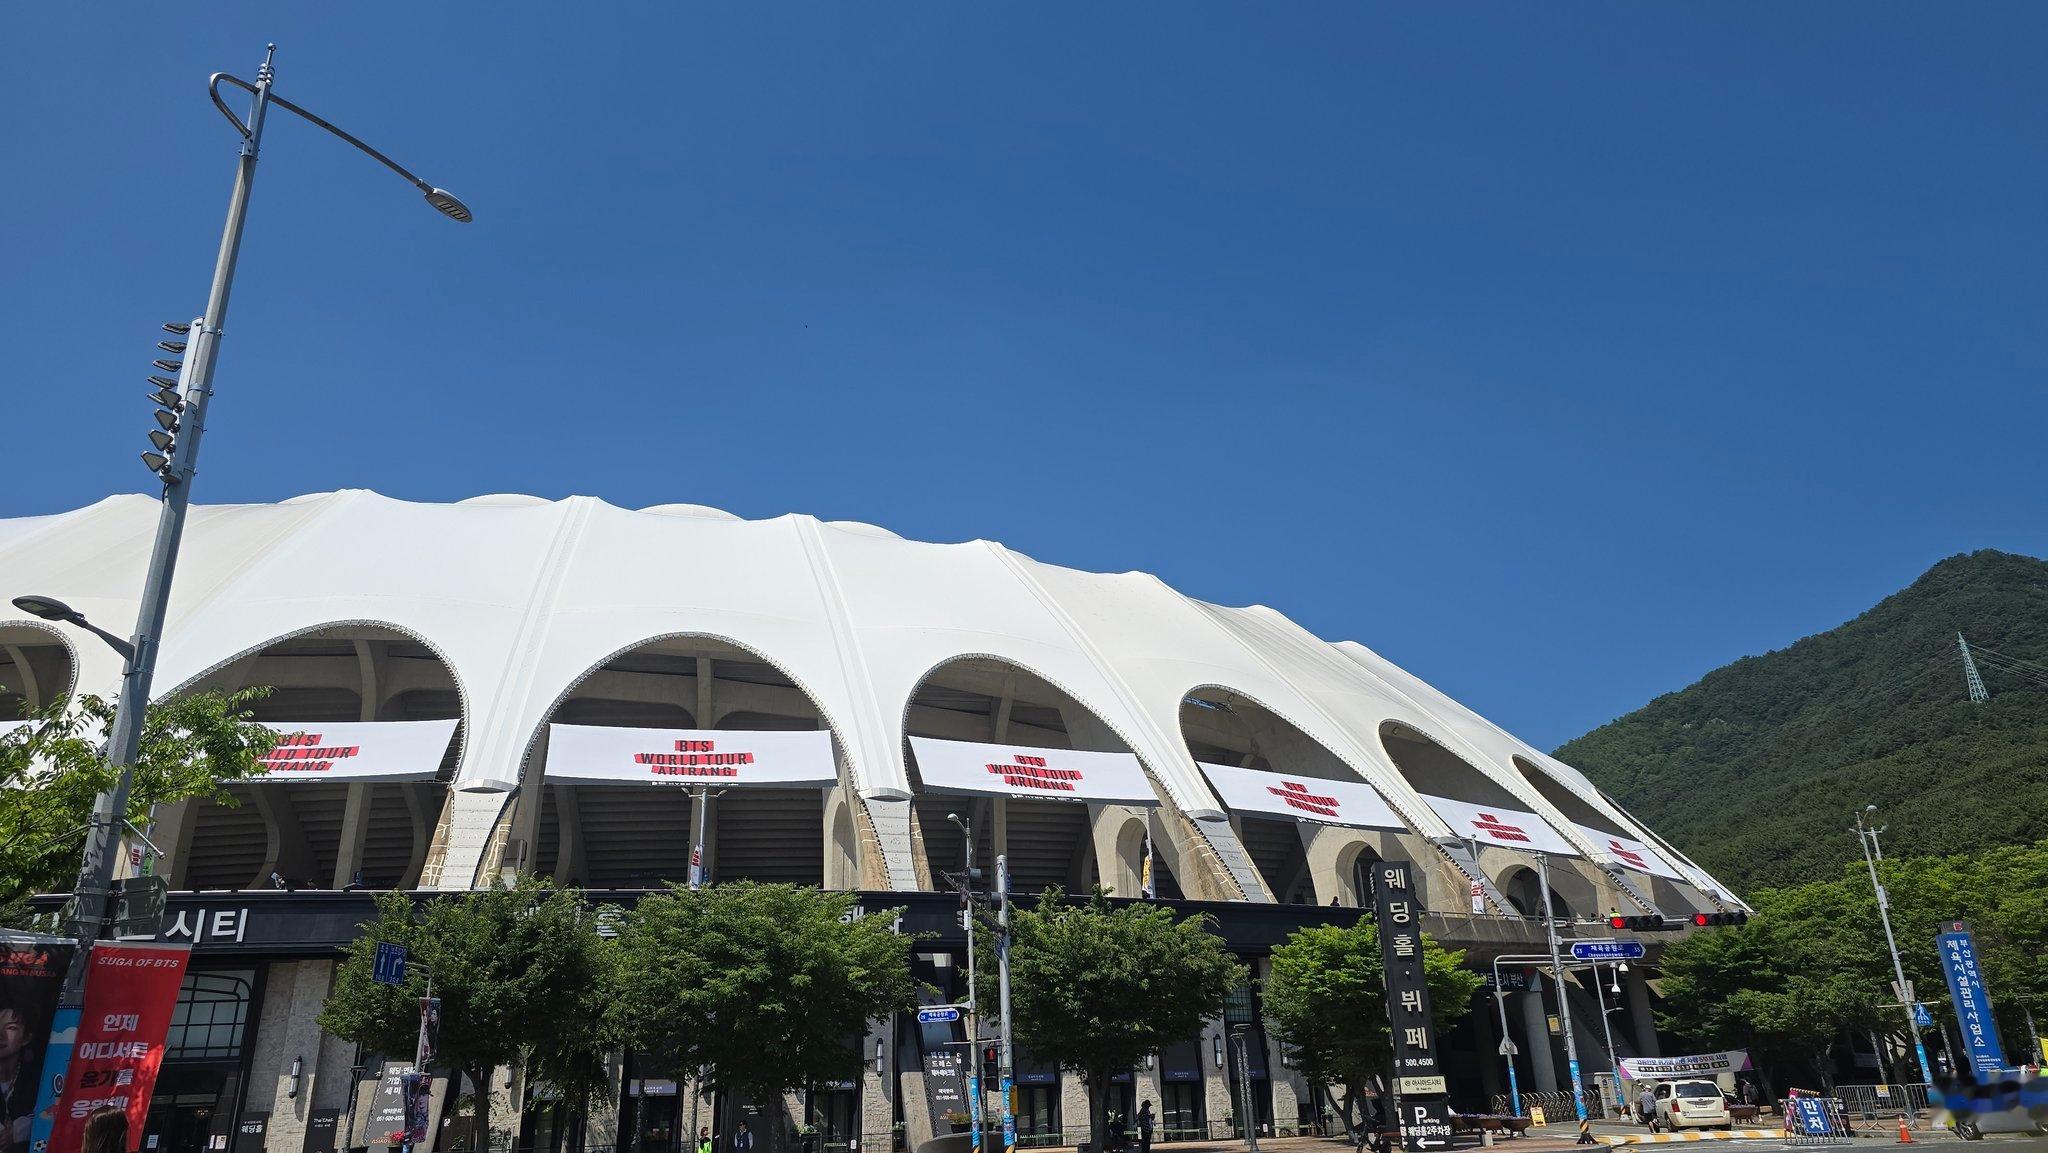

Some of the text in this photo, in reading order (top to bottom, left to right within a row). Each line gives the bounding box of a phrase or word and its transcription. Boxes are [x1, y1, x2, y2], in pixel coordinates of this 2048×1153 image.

[280, 734, 317, 746] BTS
[680, 740, 709, 752] BTS
[305, 747, 352, 759] TOUR
[640, 753, 747, 765] WORLD TOUR
[266, 761, 327, 771] IRANG
[1018, 756, 1043, 766] BTS
[658, 766, 732, 776] ARIRANG
[992, 764, 1078, 781] WORLD TOUR
[1010, 776, 1070, 791] ARIRANG
[1590, 944, 1624, 952] 체육공원로
[98, 956, 180, 968] SUGA OF BTS
[1960, 939, 1980, 989] 부산광역시
[1946, 939, 1986, 1047] 체육시설관리사업소
[102, 1014, 139, 1032] 언제
[80, 1041, 149, 1059] 어디서든
[81, 1068, 134, 1089] 윤기를
[384, 1086, 402, 1095] 세미
[1802, 1100, 1825, 1131] 만차
